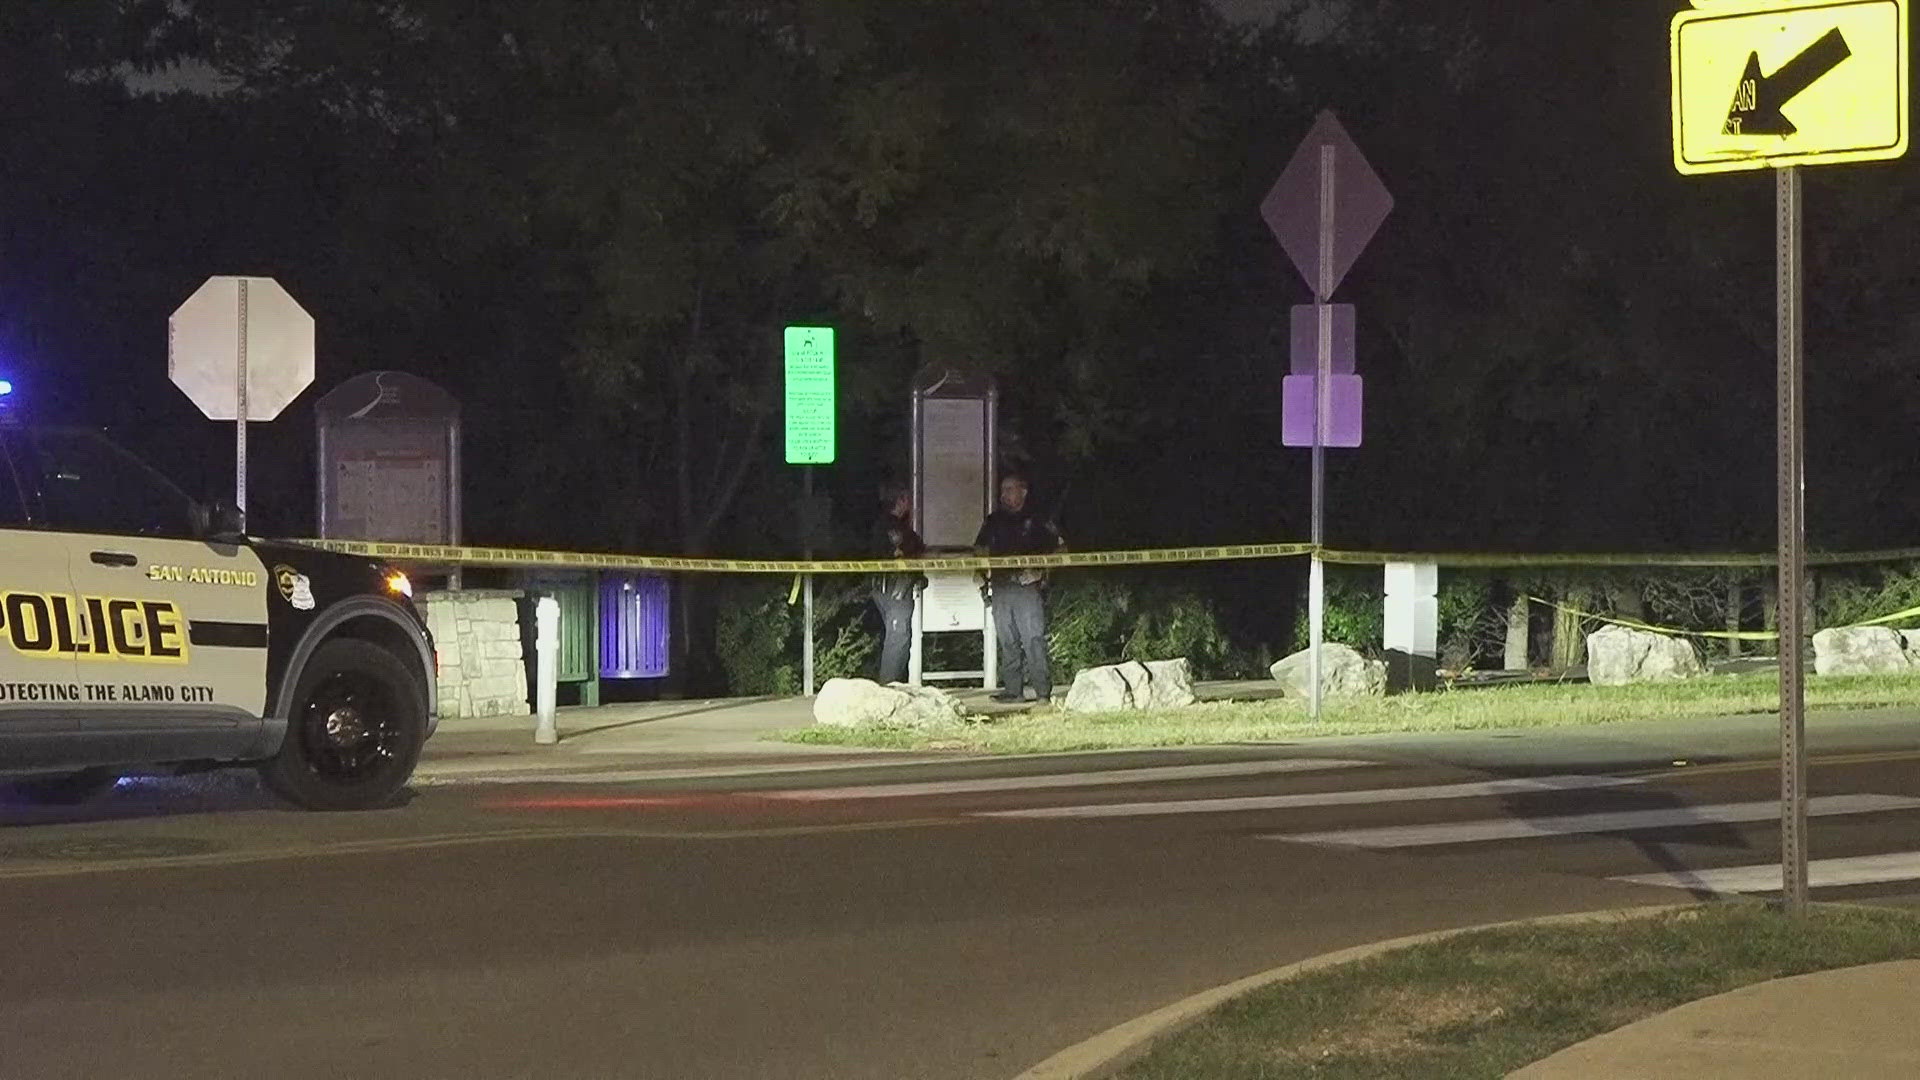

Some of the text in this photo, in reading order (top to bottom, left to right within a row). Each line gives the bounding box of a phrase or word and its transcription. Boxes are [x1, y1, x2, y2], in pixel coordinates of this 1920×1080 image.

[149, 565, 183, 581] SAN
[189, 568, 257, 587] ANTONIO
[0, 593, 180, 656] OLICE
[84, 684, 117, 701] THE
[123, 685, 175, 702] ALAMO
[181, 686, 214, 702] CITY
